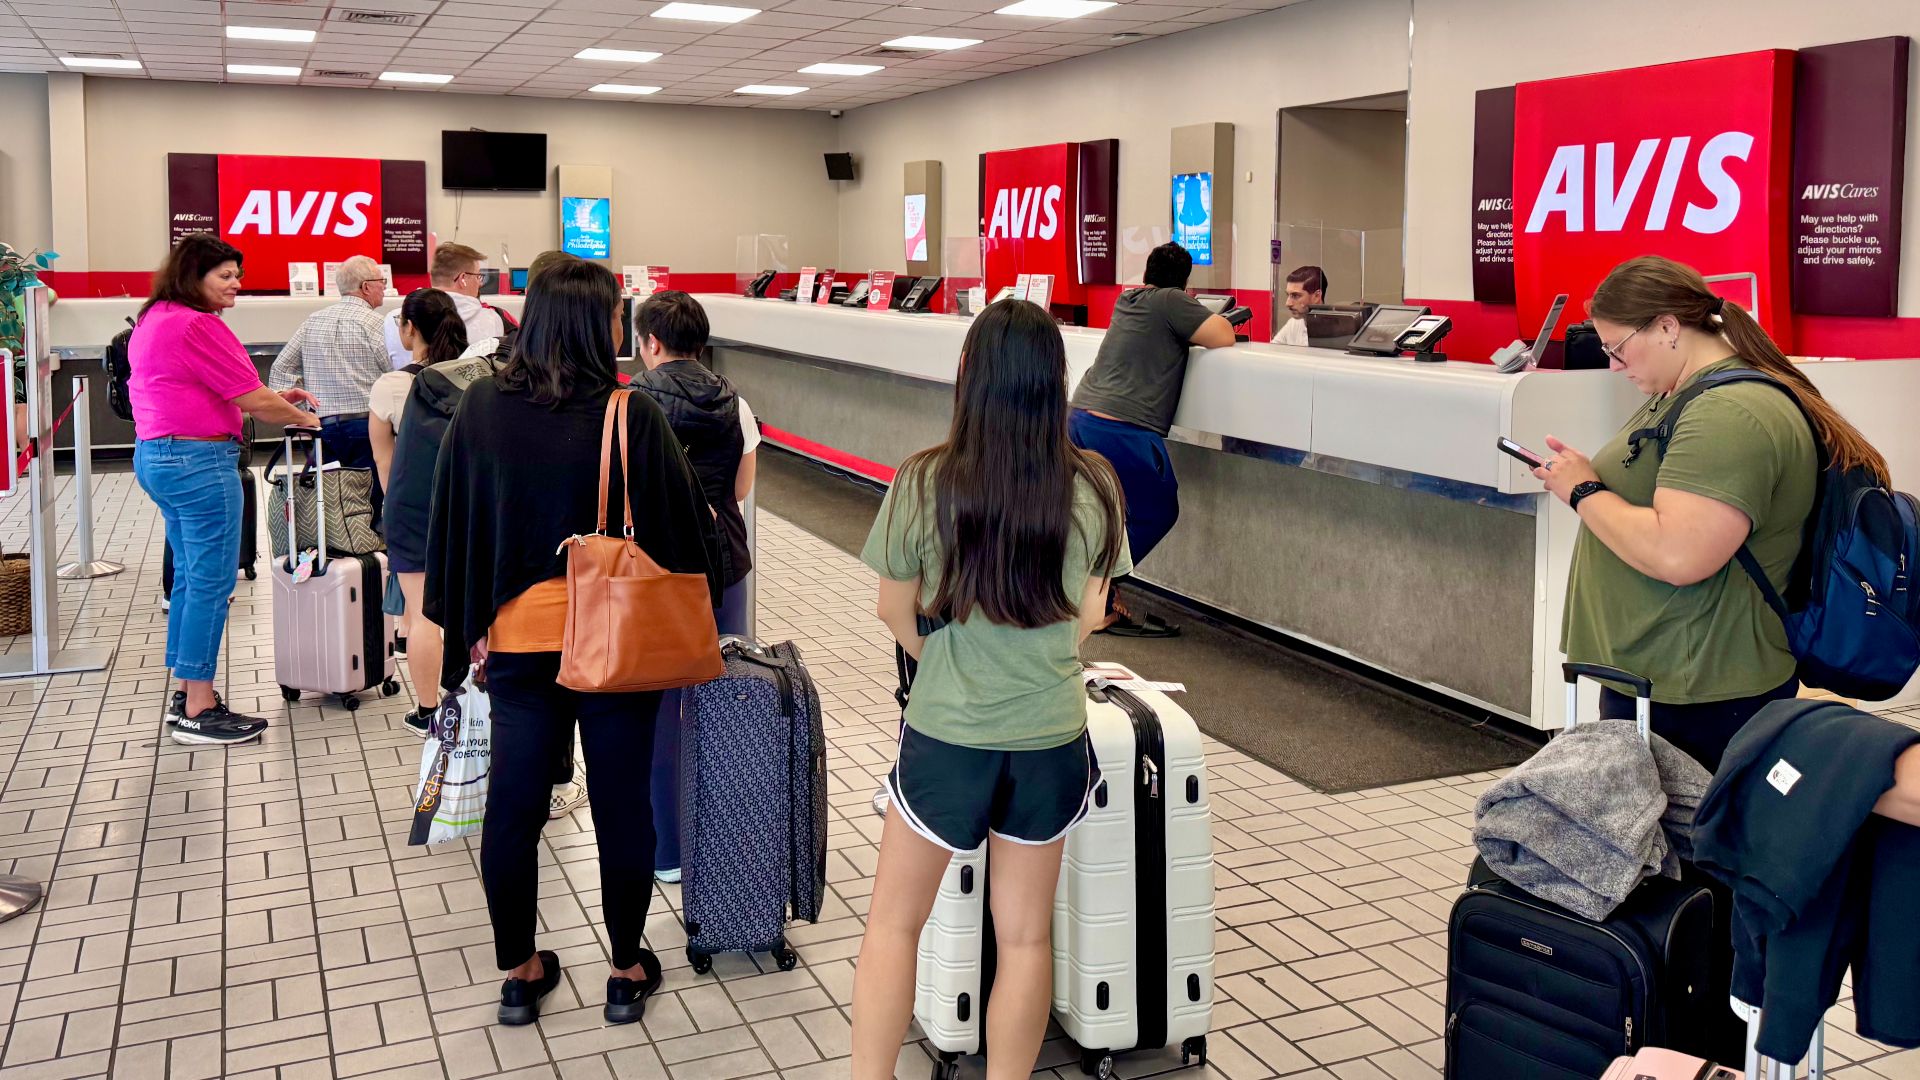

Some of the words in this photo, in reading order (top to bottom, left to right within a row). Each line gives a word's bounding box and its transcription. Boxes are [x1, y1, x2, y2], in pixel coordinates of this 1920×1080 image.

[1524, 131, 1755, 234] AVIS
[228, 189, 374, 238] AVIS
[988, 184, 1062, 241] AVIS
[1801, 214, 1819, 225] May
[1837, 214, 1856, 224] help
[1859, 213, 1878, 222] with
[1477, 222, 1490, 231] May
[1814, 224, 1864, 234] directions?
[1800, 236, 1829, 244] Please
[1832, 235, 1862, 244] buckle
[1865, 236, 1880, 245] up,
[1476, 248, 1492, 256] adjust
[1798, 246, 1824, 256] adjust
[1826, 247, 1846, 256] your
[1849, 246, 1882, 254] mirrors
[1804, 256, 1820, 264] and
[1822, 256, 1844, 264] drive
[1847, 256, 1876, 266] safely.
[178, 717, 200, 730] HOKA
